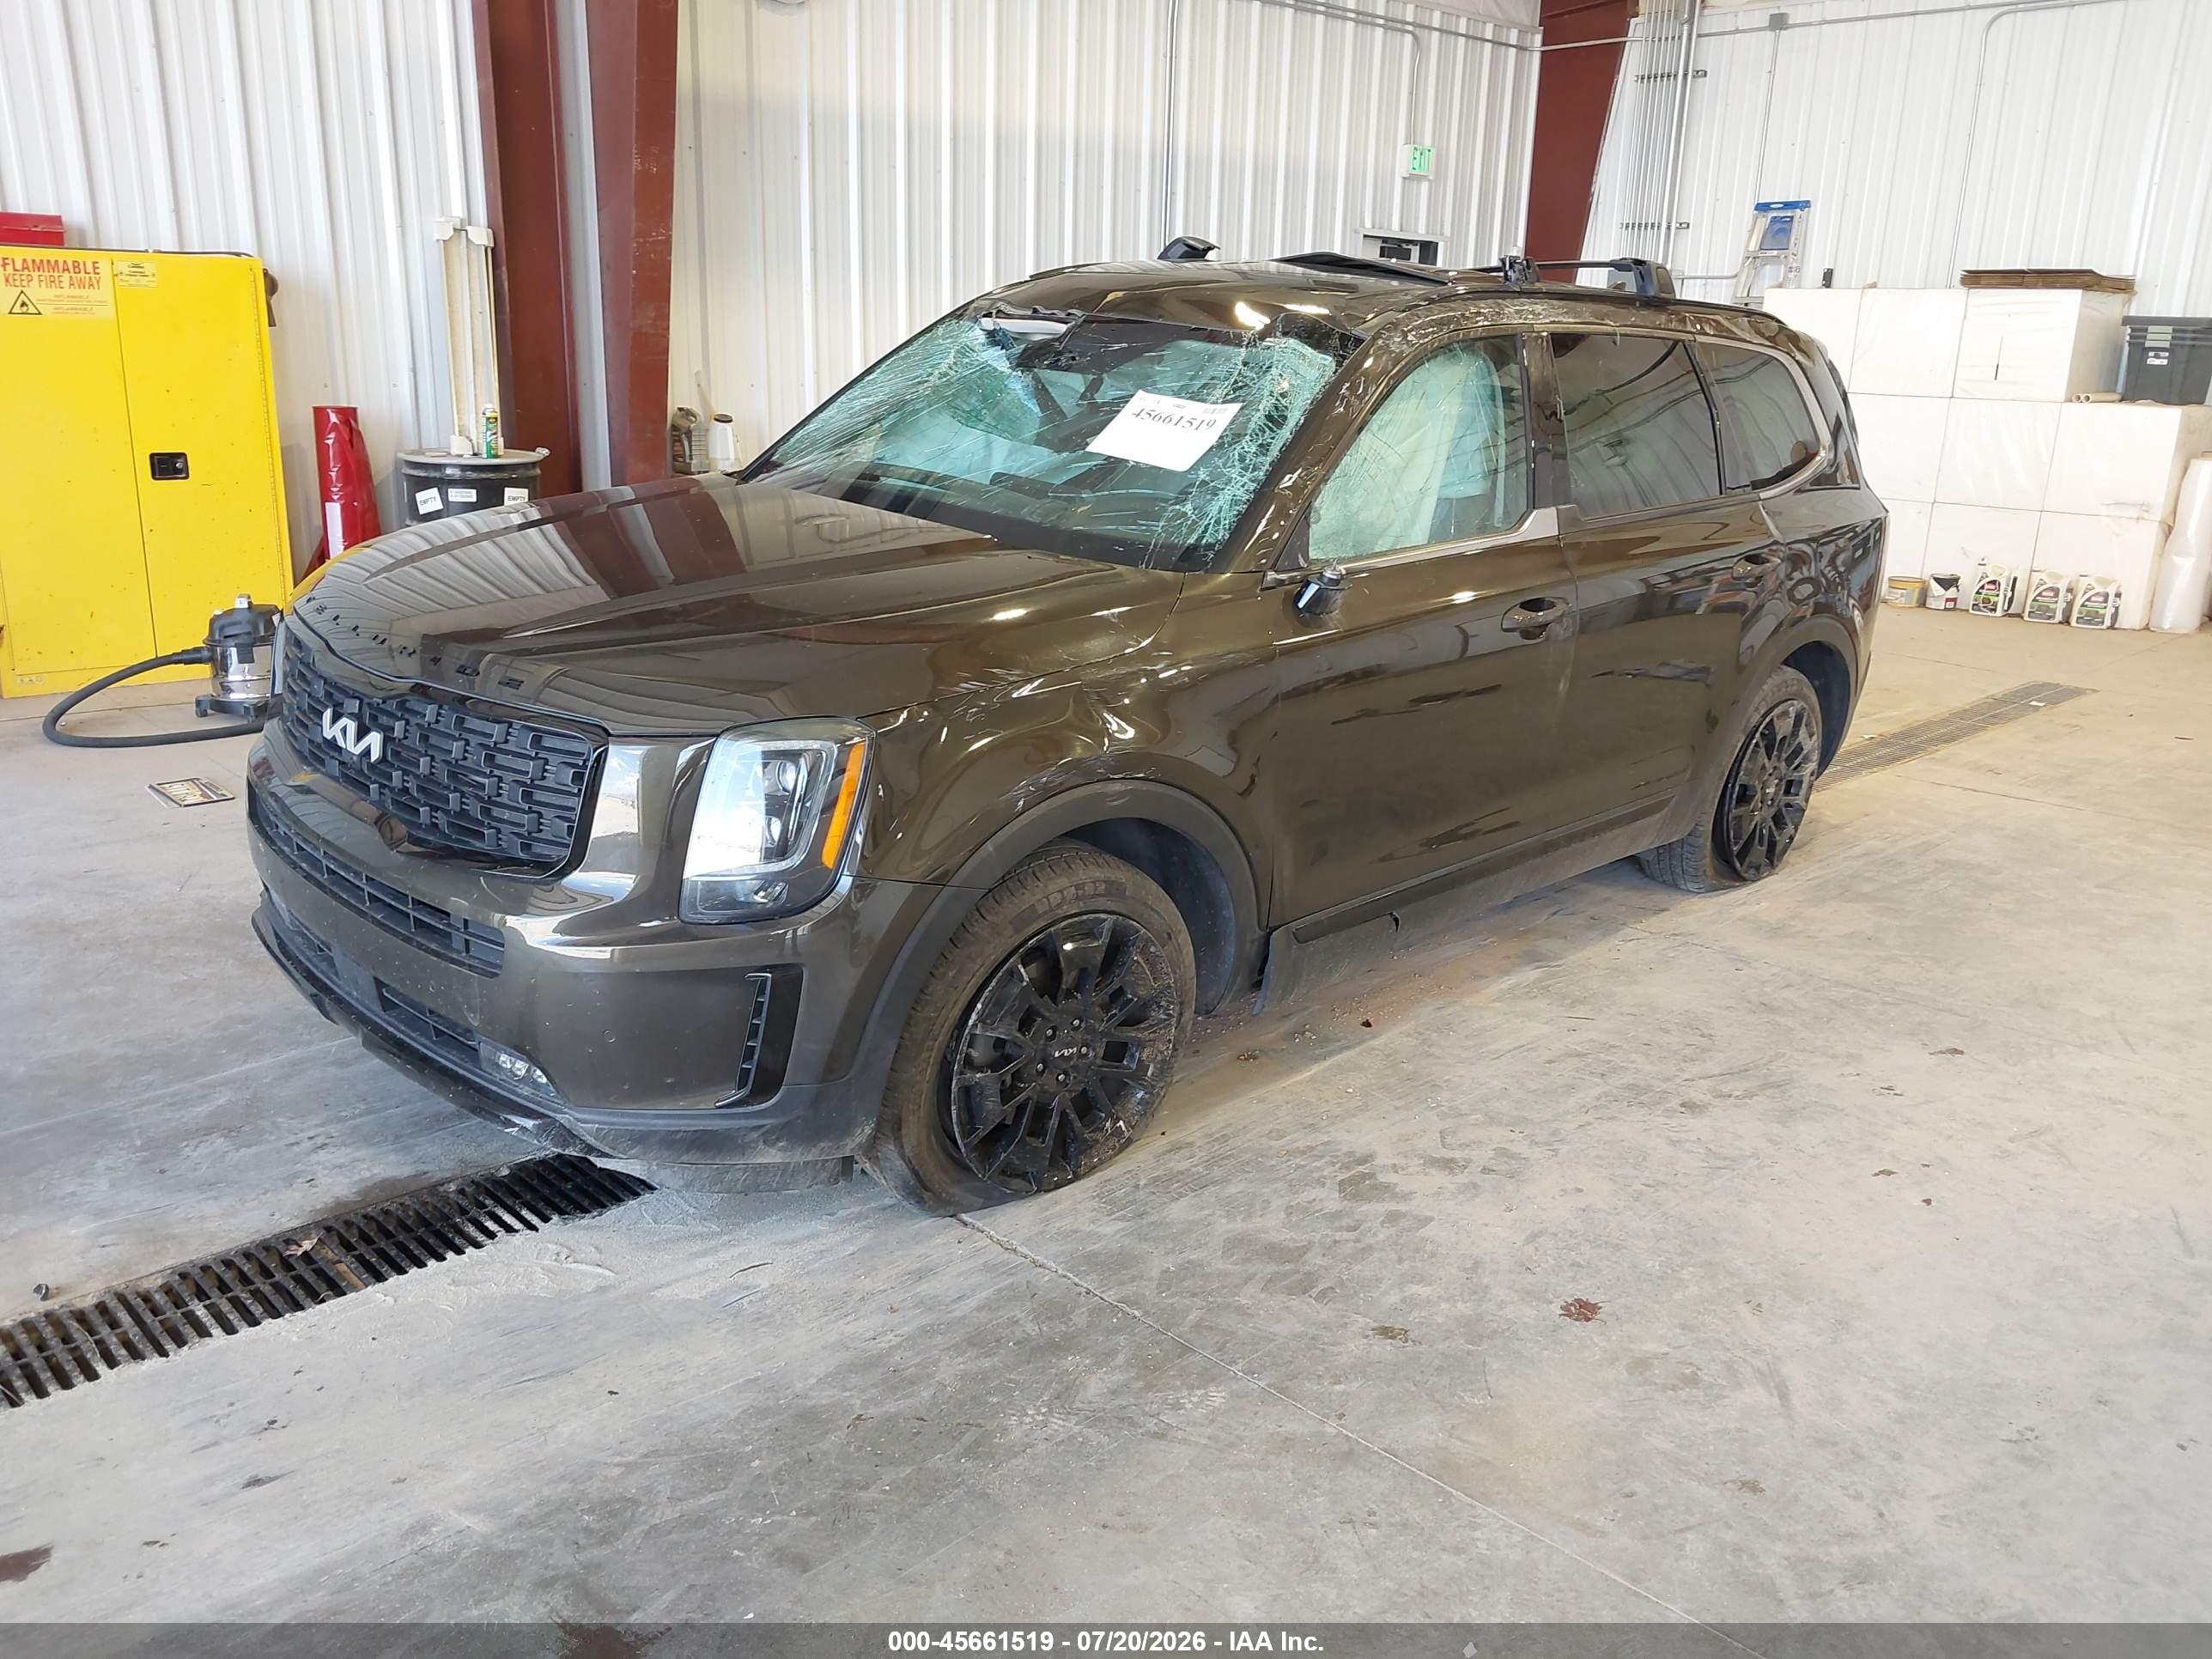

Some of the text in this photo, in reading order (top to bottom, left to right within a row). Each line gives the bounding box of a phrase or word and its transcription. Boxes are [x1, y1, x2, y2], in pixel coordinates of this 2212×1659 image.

[1412, 147, 1431, 172] EXIT
[2, 257, 100, 275] FLAMMABLE
[4, 273, 101, 290] KEEP FIRE AWAY
[1132, 408, 1217, 430] 45661519
[419, 496, 437, 506] EMPTY
